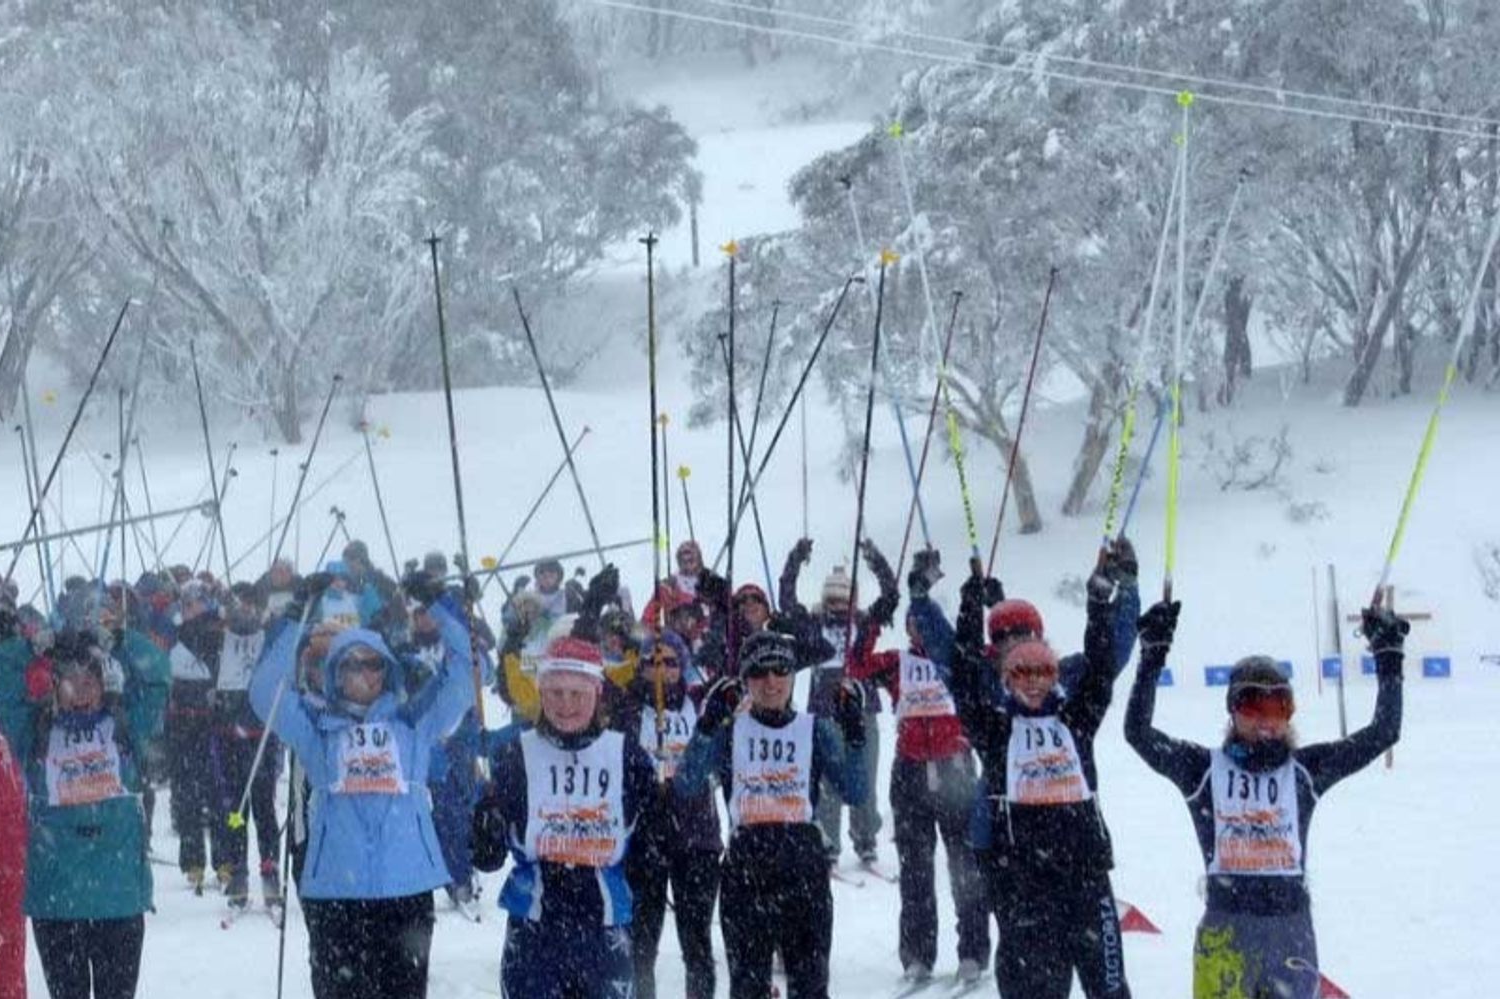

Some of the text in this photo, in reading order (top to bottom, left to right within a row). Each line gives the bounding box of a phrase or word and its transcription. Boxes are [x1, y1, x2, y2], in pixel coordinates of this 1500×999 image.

[748, 738, 796, 763] 1302
[550, 765, 610, 798] 1319
[1228, 770, 1278, 805] 1310
